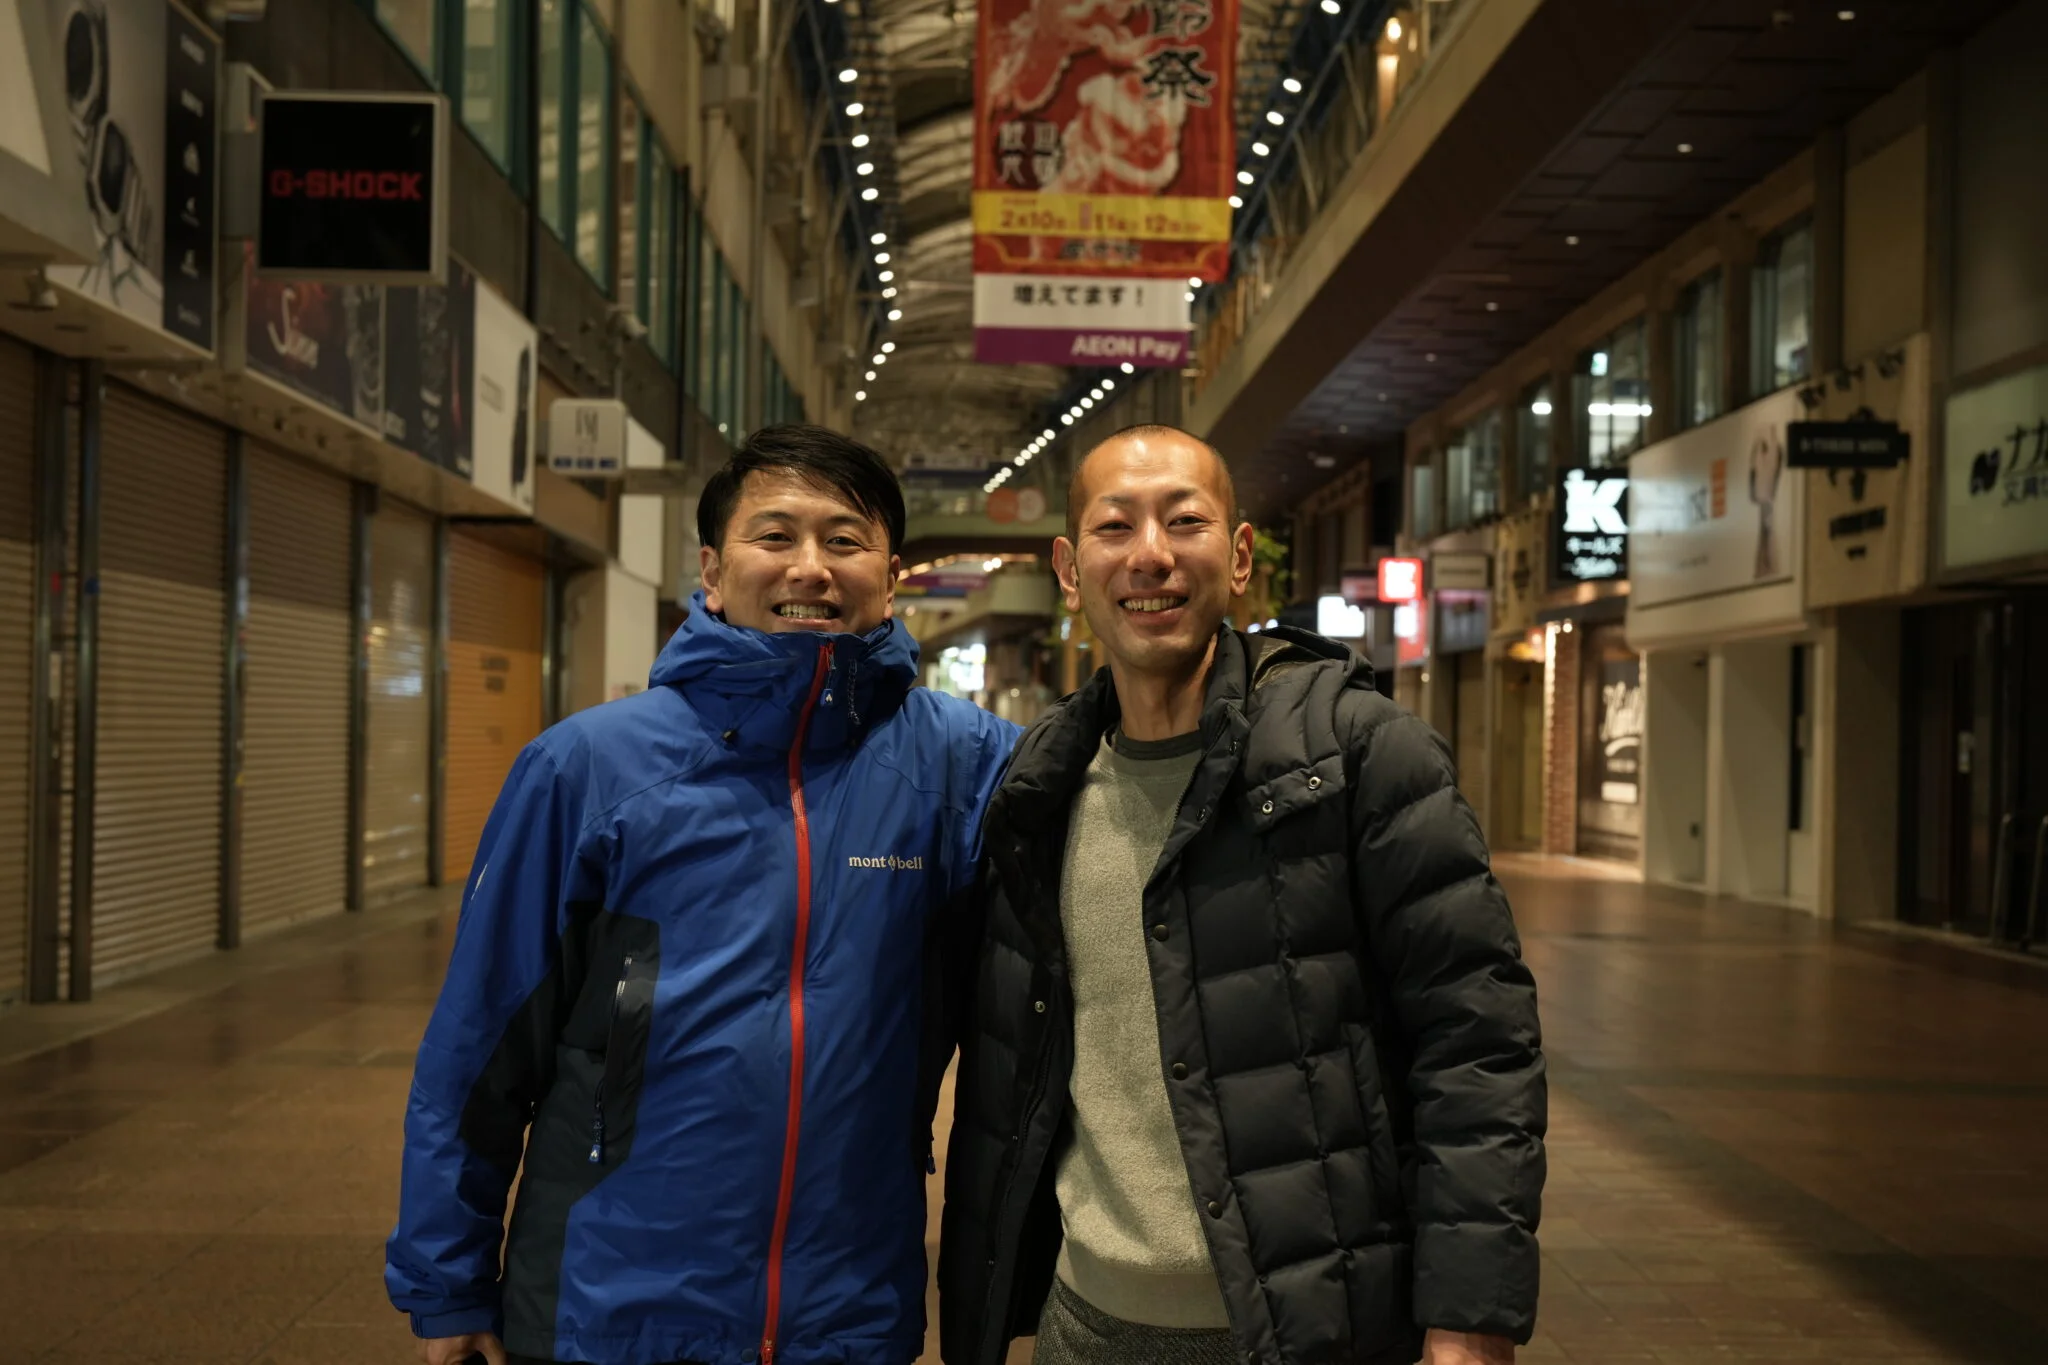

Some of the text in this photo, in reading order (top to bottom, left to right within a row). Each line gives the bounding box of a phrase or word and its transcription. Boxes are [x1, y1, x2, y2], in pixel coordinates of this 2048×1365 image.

[270, 168, 422, 201] G-SHOCK
[1071, 334, 1182, 362] AEON Pay
